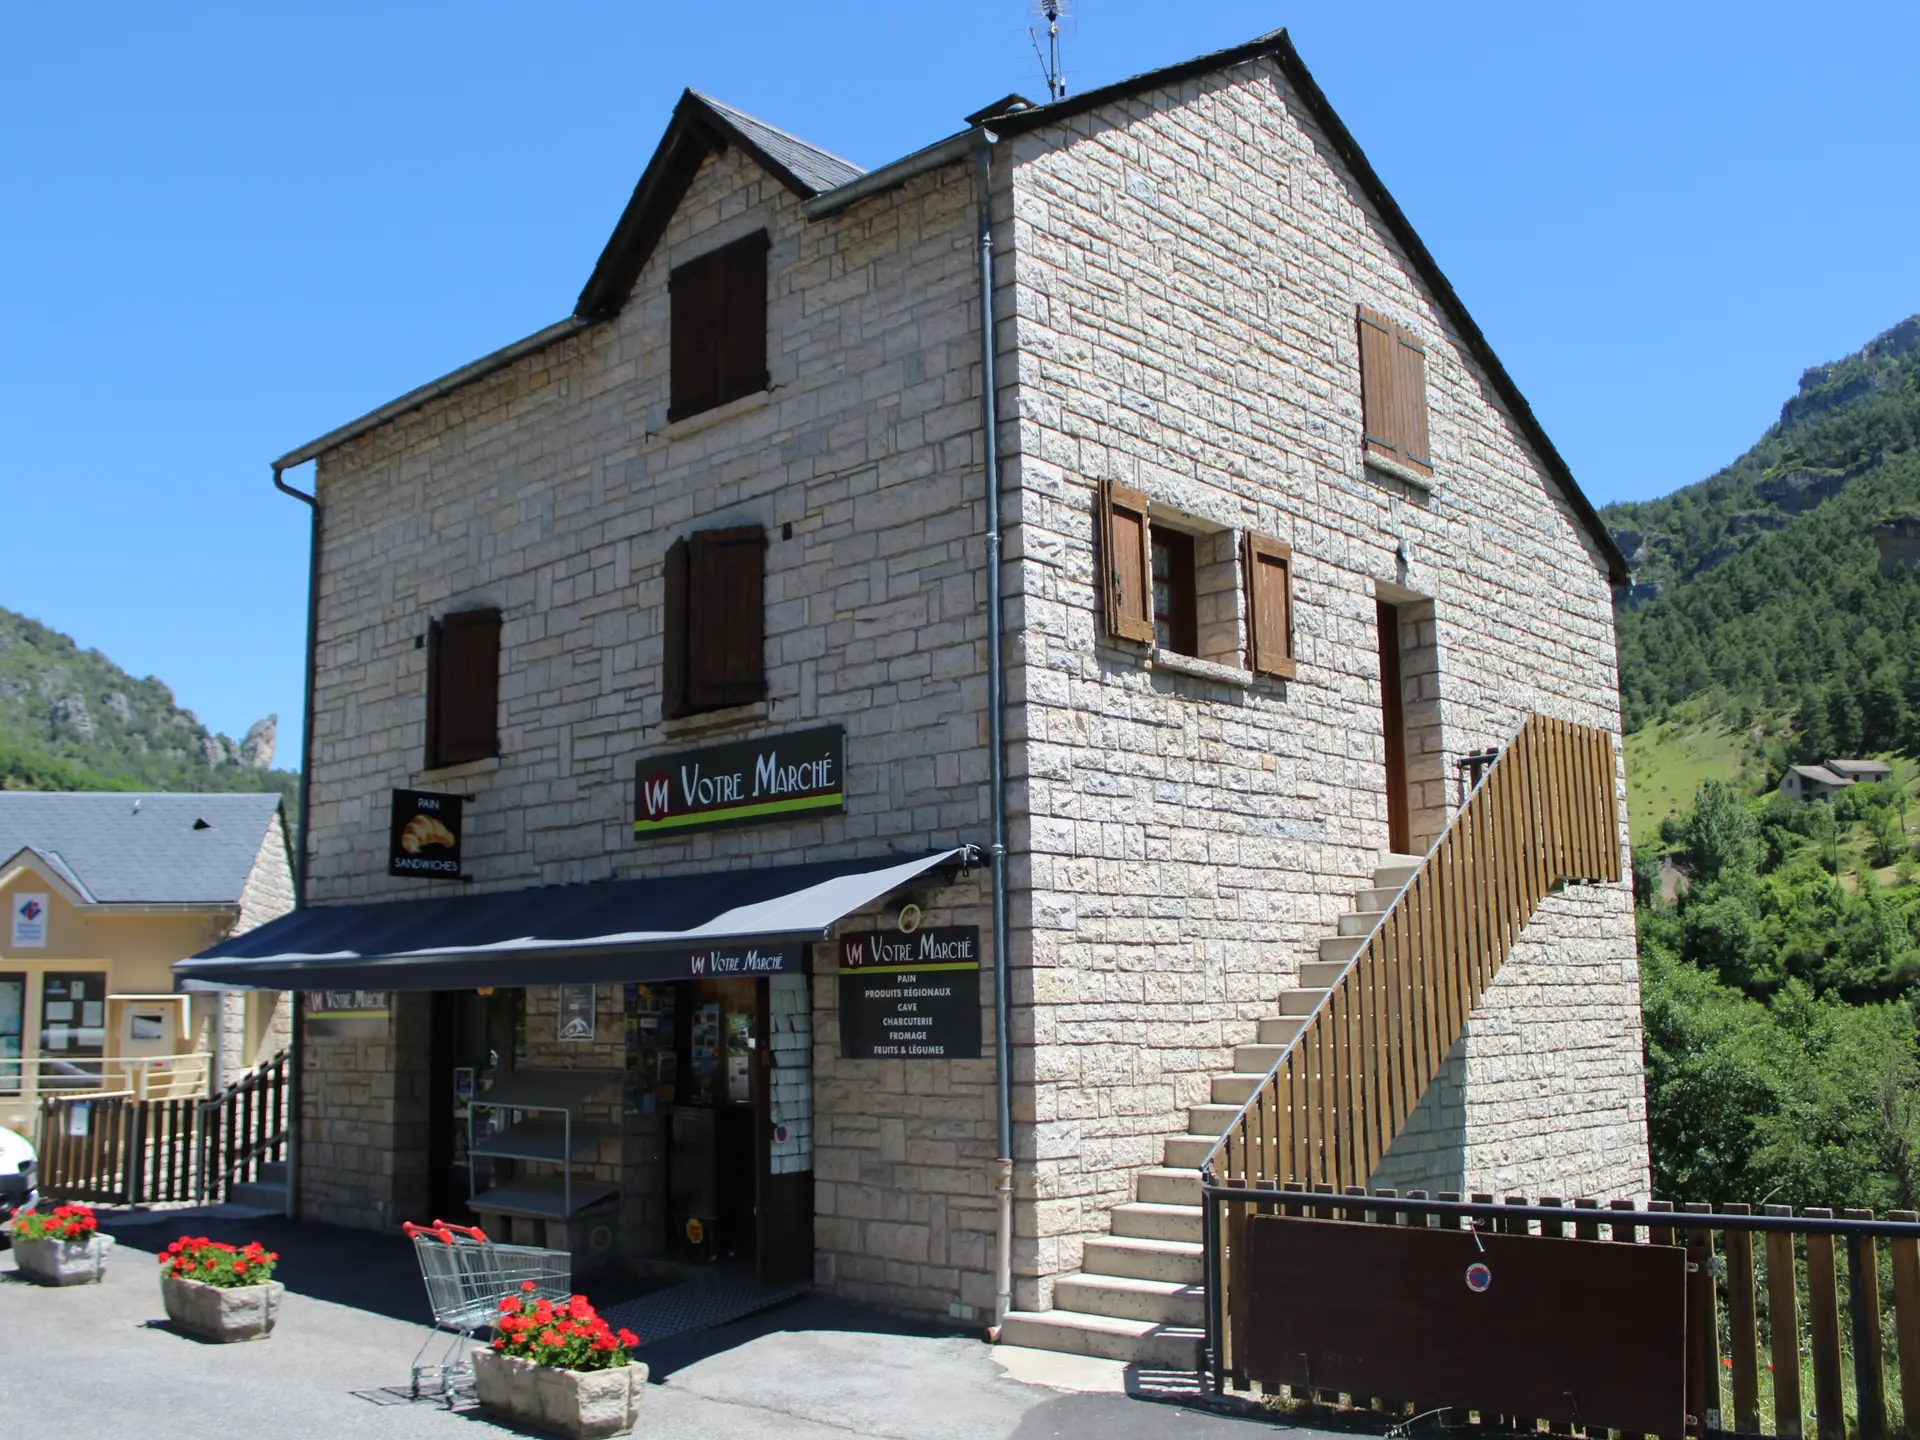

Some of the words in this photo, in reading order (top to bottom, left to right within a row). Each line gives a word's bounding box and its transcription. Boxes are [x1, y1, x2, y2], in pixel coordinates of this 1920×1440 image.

[644, 778, 669, 815] VM
[681, 763, 745, 807] VOTRE
[752, 750, 835, 797] MARCHÉ
[417, 798, 440, 810] PAIN
[394, 857, 458, 871] SANDWICHES
[870, 936, 913, 962] VOTRE
[918, 932, 973, 960] MARCHÉ
[710, 951, 740, 972] VOTRE
[742, 949, 783, 971] MARCHÉ
[897, 974, 916, 983] PAIN
[865, 989, 902, 998] PRODUITS
[903, 987, 951, 997] RÉGIONAUX
[897, 1003, 918, 1012] CAVE
[882, 1017, 933, 1026] CHARCUTERIE
[889, 1031, 927, 1040] FROMAGE
[873, 1045, 899, 1054] FRUITS
[900, 1045, 906, 1054] &
[908, 1044, 945, 1054] LÉGUMES
